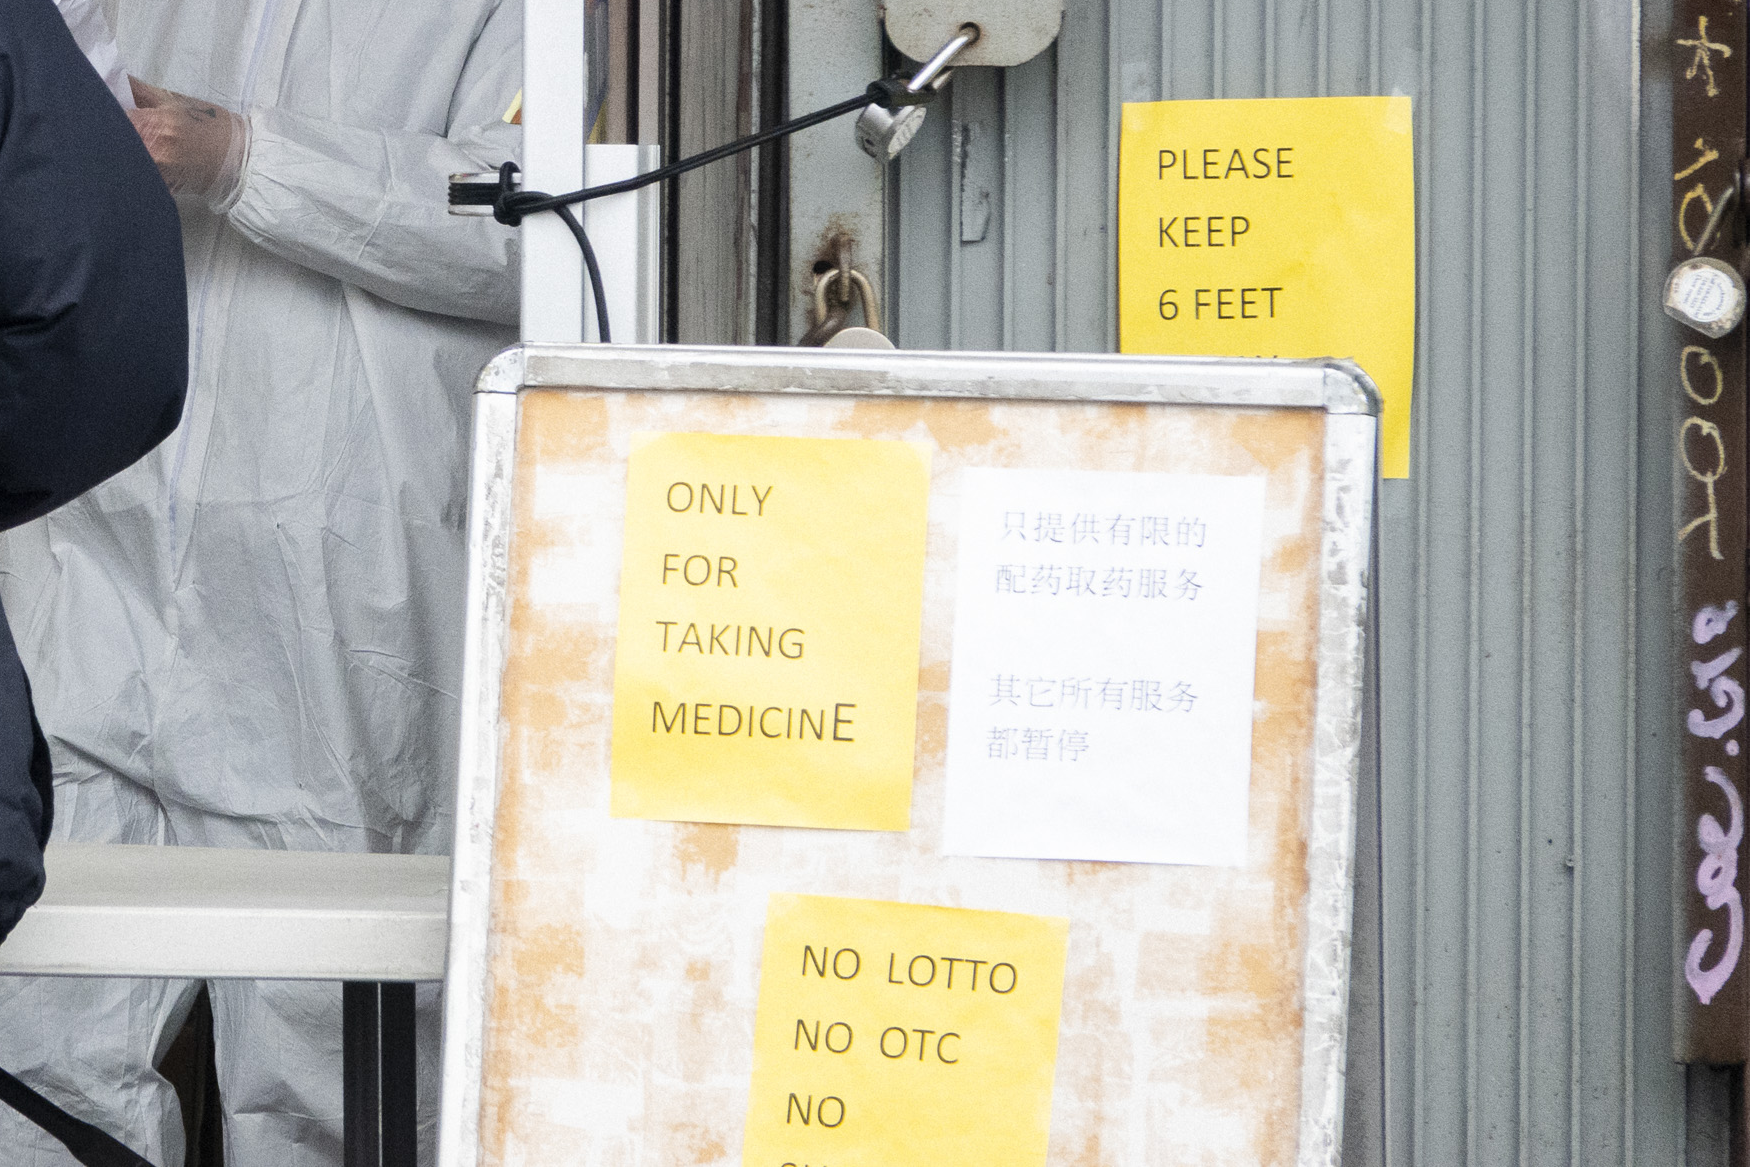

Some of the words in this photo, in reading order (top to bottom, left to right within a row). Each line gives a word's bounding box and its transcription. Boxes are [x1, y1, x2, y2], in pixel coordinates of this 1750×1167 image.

[1158, 147, 1295, 180] PLEASE
[1159, 216, 1250, 248] KEEP
[1159, 289, 1179, 320] 6
[1194, 287, 1284, 320] FEET
[666, 481, 773, 516] ONLY
[1002, 510, 1207, 548] 只提供有限的
[661, 554, 739, 588] FOR
[995, 563, 1203, 602] 配药取药服务
[656, 620, 805, 659] TAKING
[988, 673, 1199, 713] 其它所有服务
[651, 701, 857, 743] MEDICINE
[986, 726, 1091, 763] 都暂停
[801, 944, 862, 980] NO
[887, 952, 1018, 995] LOTTO
[793, 1018, 854, 1054] NO
[879, 1026, 962, 1065] OTC
[786, 1092, 847, 1129] NO
